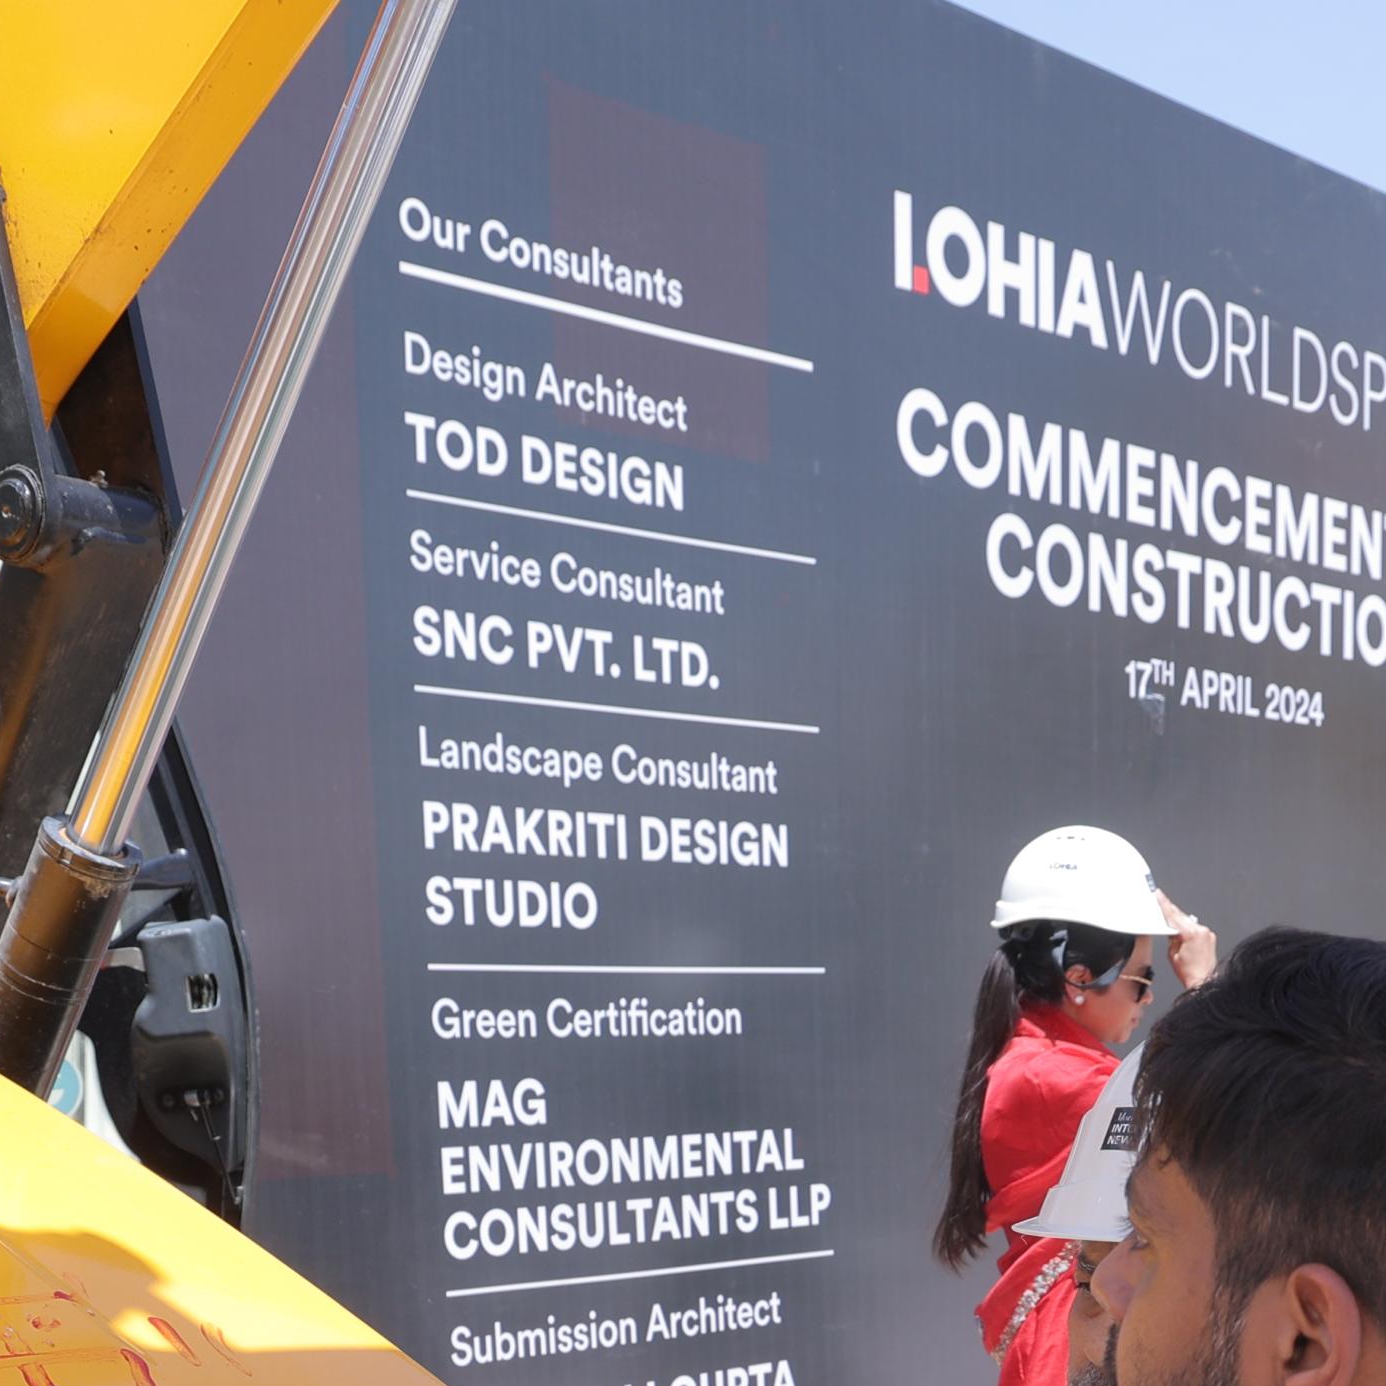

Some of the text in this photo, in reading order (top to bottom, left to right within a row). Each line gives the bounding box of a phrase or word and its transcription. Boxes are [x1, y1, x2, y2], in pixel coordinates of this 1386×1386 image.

[399, 197, 684, 308] Our Consultants
[403, 331, 688, 432] Design Architect
[404, 411, 684, 511] TOD DESIGN
[409, 529, 725, 615] Service Consultant
[413, 605, 720, 690] SNC PVT. LTD.
[1180, 666, 1260, 718] APRIL
[1265, 682, 1325, 727] 2024
[419, 725, 778, 794] Landscape Consultant
[422, 800, 789, 868] PRAKRITI DESIGN
[425, 876, 598, 930] STUDIO
[431, 997, 743, 1039] Green Certification
[436, 1077, 547, 1129] MAG
[440, 1127, 805, 1195] ENVIRONMENTAL
[444, 1183, 831, 1260] CONSULTANTS LLP
[450, 1291, 782, 1367] Submission Architect
